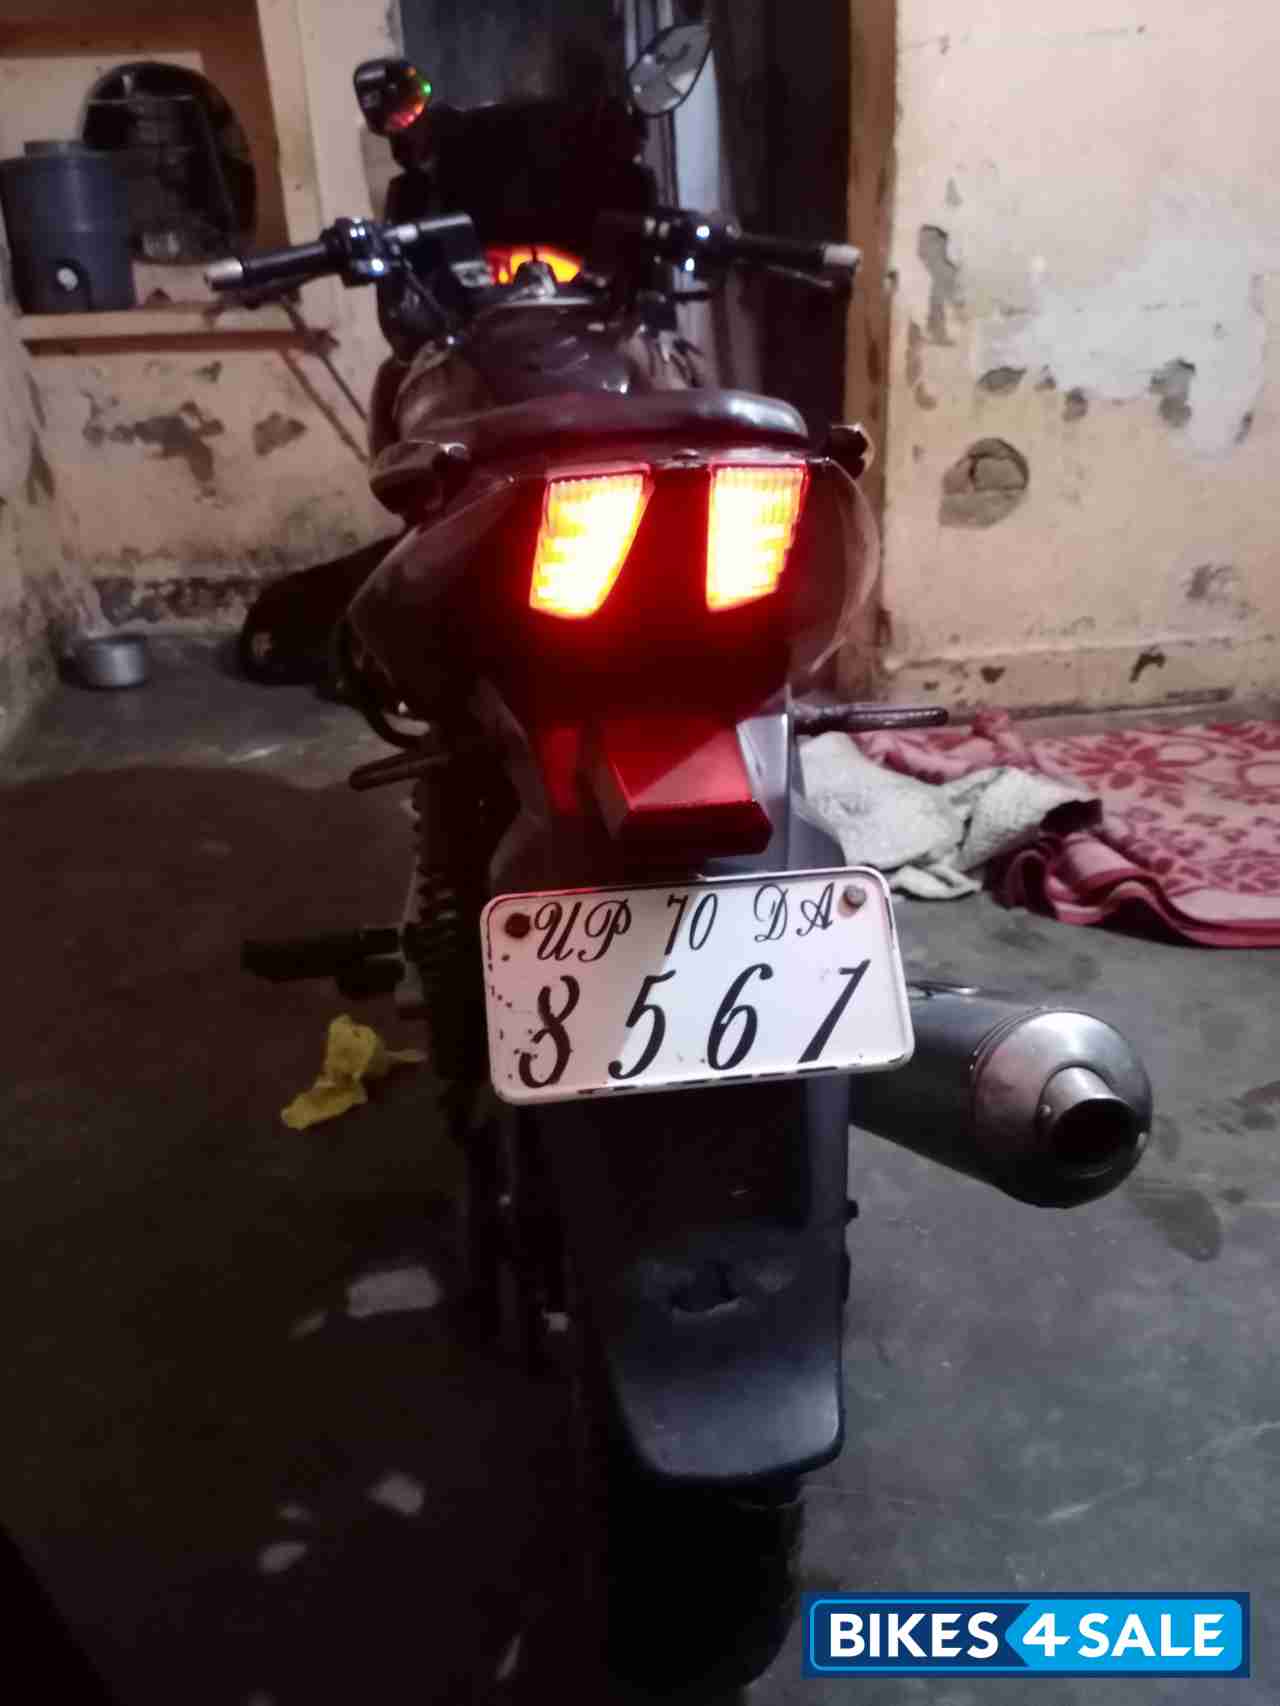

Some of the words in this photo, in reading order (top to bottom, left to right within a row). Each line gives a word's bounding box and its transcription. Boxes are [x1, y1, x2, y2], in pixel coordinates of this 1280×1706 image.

[533, 899, 632, 962] UP
[664, 893, 718, 956] 70
[753, 883, 835, 942] DA
